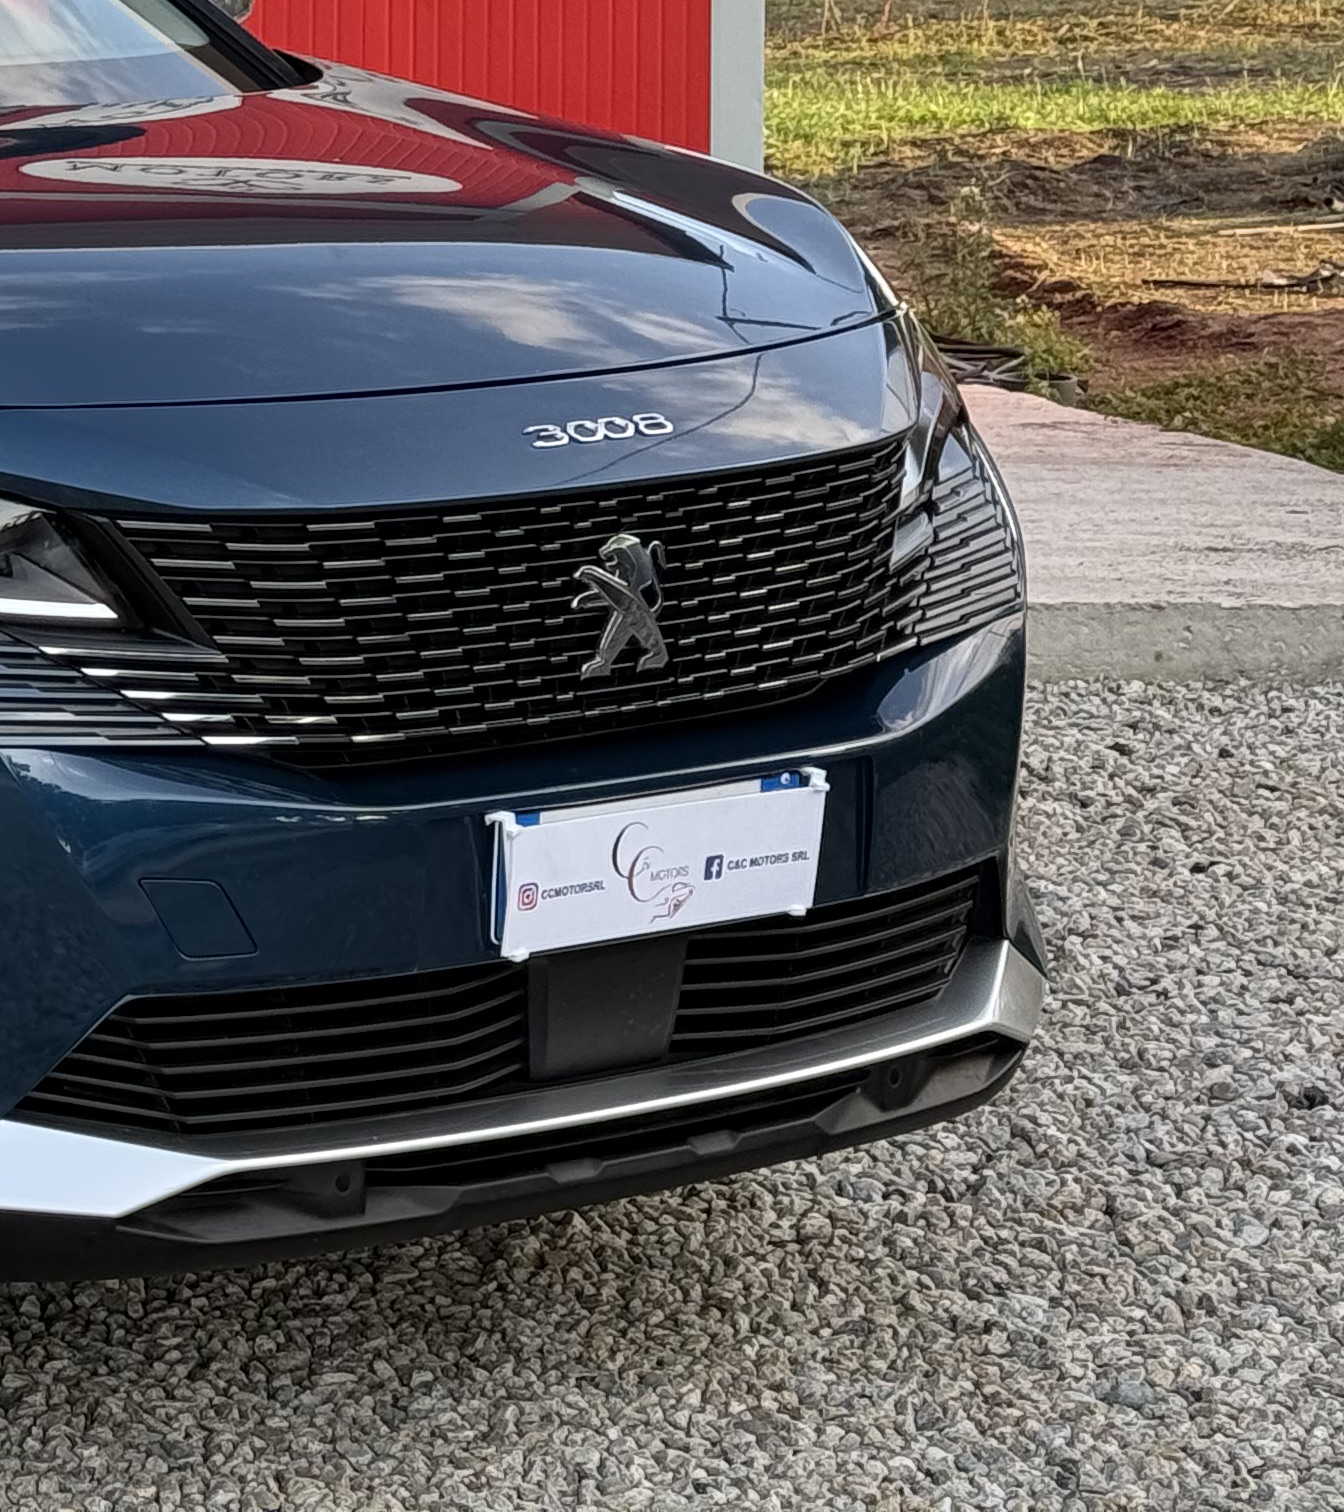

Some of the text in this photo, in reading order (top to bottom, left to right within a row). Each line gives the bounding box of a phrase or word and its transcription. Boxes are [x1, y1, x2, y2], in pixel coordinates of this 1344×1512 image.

[522, 412, 674, 448] 3008
[727, 850, 811, 871] C&C MOTORS SRL
